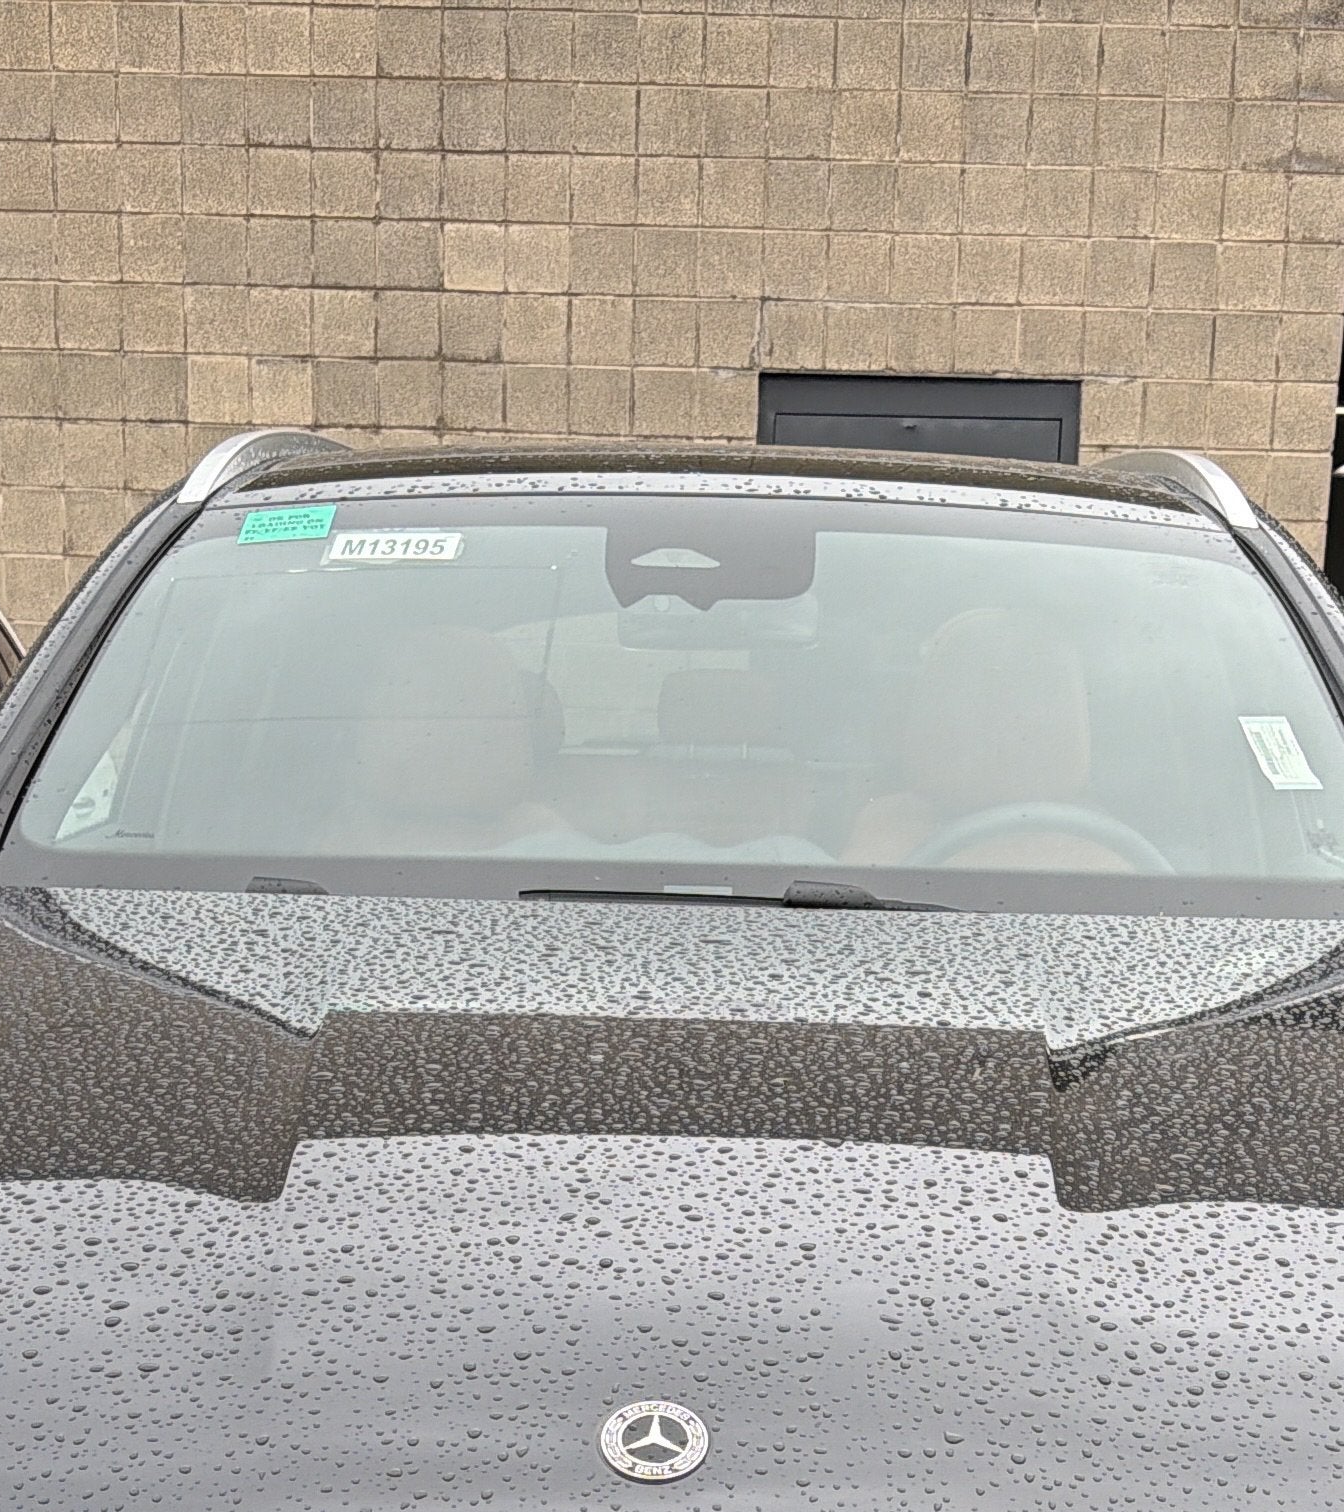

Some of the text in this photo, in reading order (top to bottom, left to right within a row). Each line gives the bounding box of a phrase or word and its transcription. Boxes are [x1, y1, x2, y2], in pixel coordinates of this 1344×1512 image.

[340, 538, 447, 555] M13195
[623, 1404, 690, 1421] MERCEDES
[634, 1464, 673, 1475] BENZ
